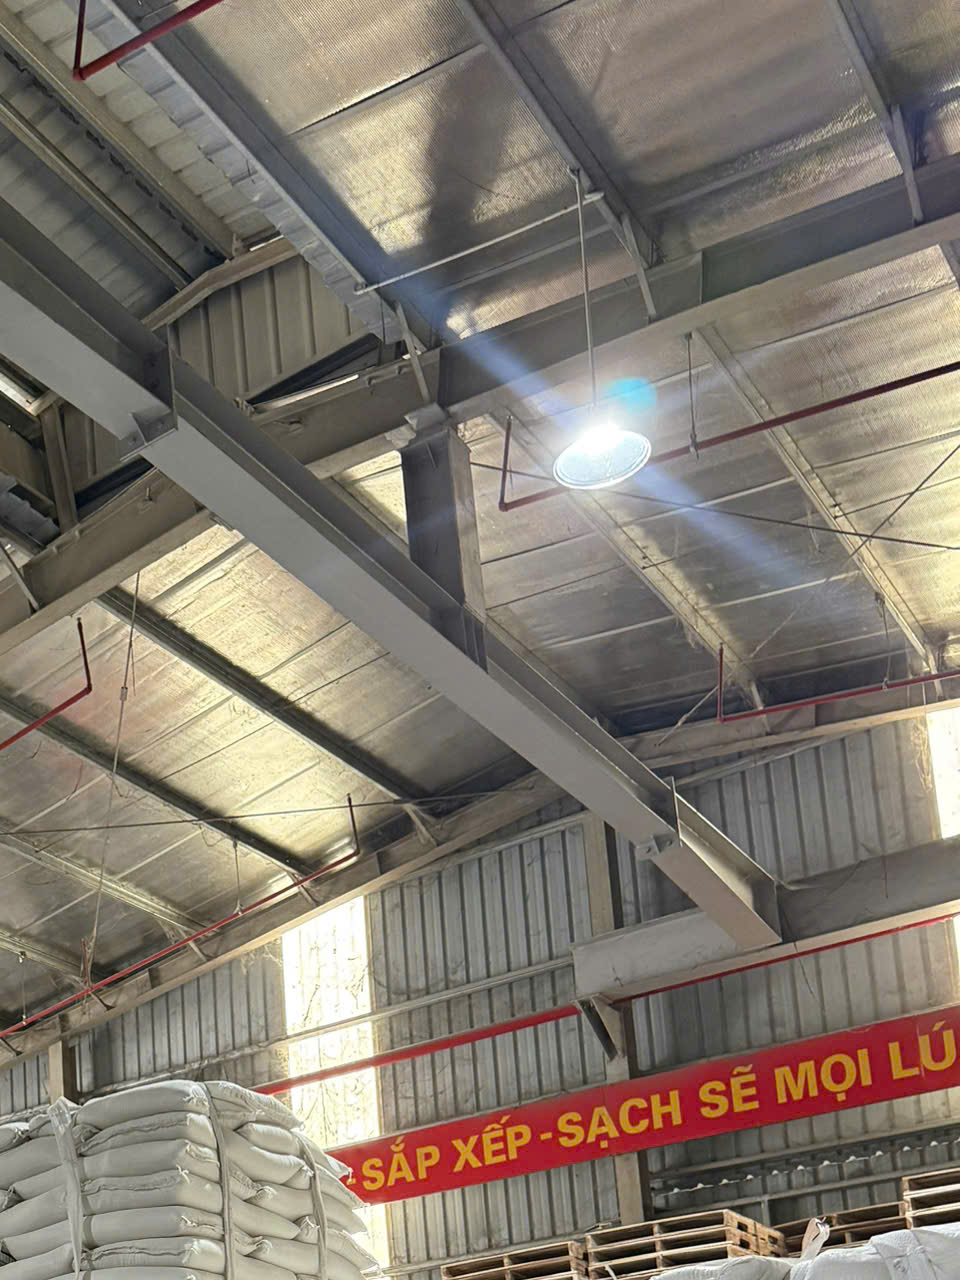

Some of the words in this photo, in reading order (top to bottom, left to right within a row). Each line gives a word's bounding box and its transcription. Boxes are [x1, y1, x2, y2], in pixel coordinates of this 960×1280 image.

[361, 1134, 441, 1192] SẮP
[698, 1063, 760, 1119] SẼ
[774, 1048, 873, 1103] MỌI
[888, 1020, 957, 1080] LÚ
